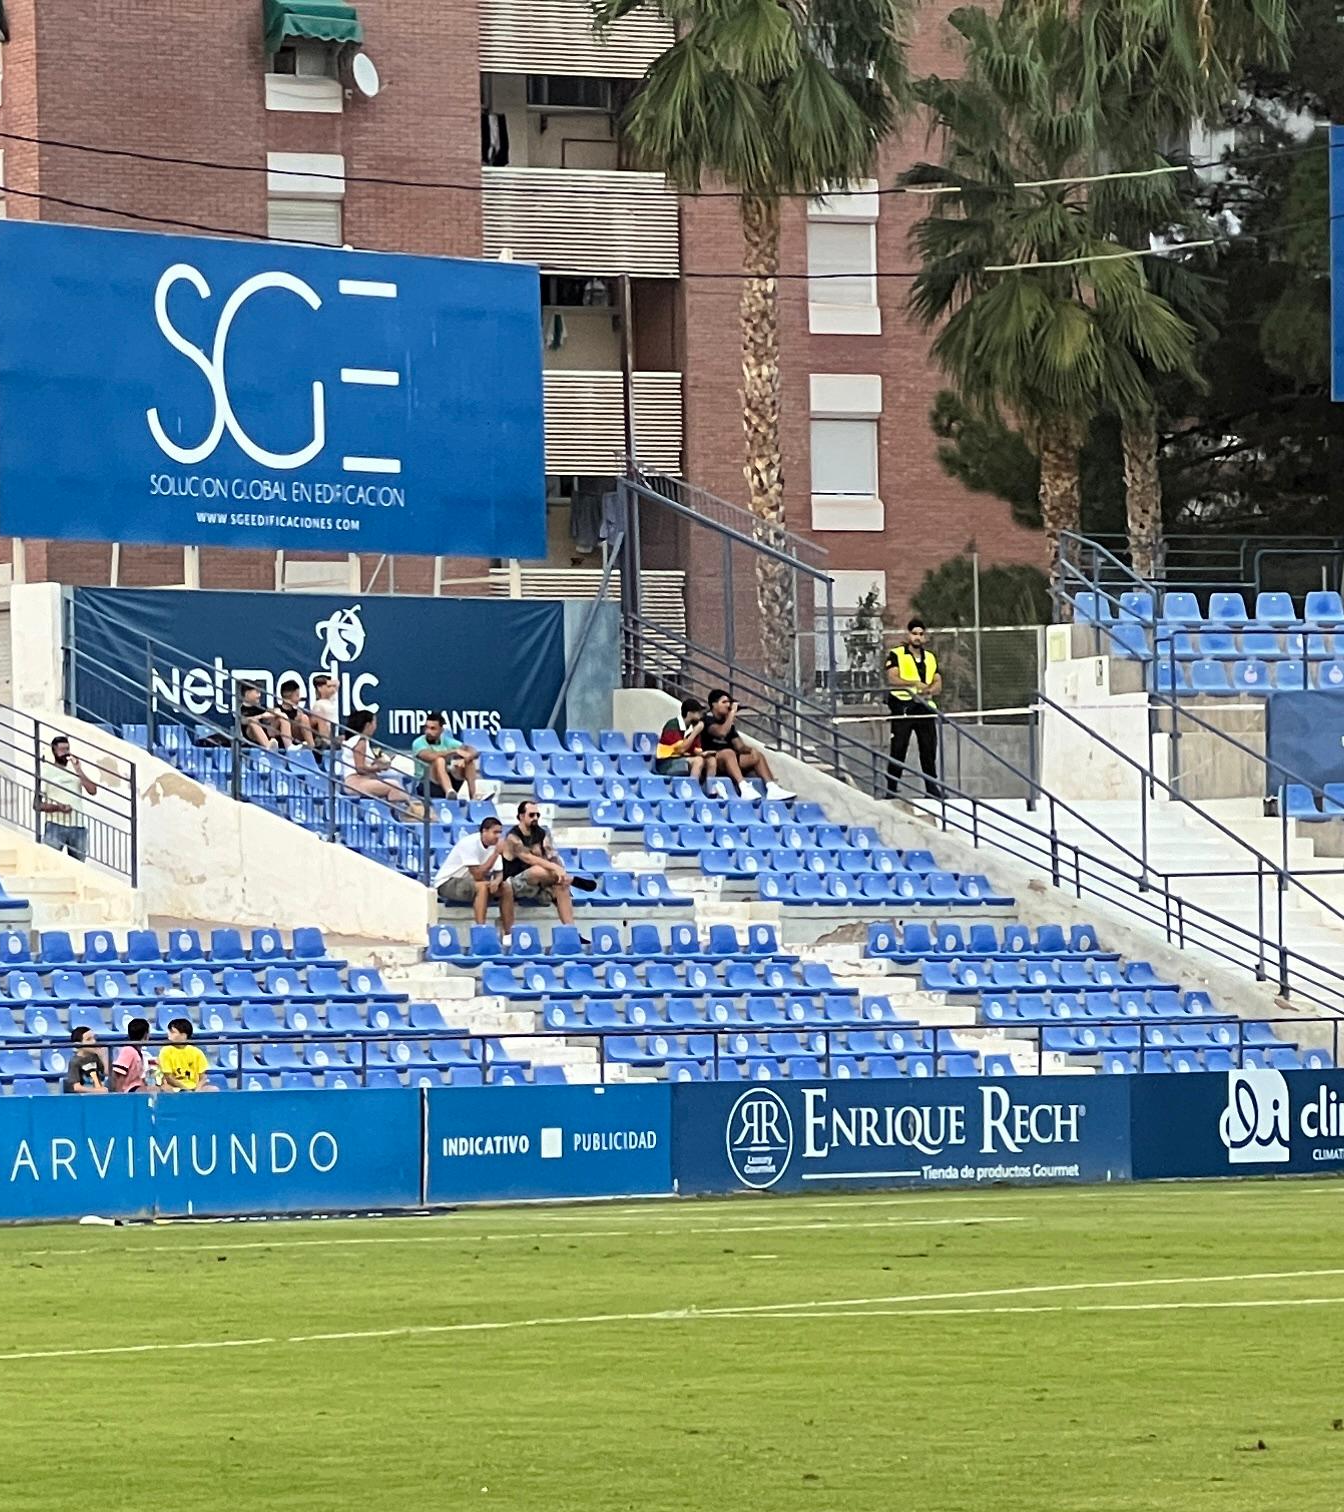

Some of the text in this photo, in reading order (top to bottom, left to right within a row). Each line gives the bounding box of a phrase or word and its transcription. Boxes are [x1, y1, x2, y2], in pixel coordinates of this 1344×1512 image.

[147, 263, 402, 474] SGE
[150, 474, 405, 507] SOLUCON GLOBAL EN EDFCACON
[196, 512, 360, 531] WWWSGEEDIFICACIONESCOM
[389, 709, 501, 735] IMPANTES
[443, 1130, 657, 1156] INDICATIVO PUBLICIDAD
[921, 1163, 1079, 1181] Tienda de productos Gourmet
